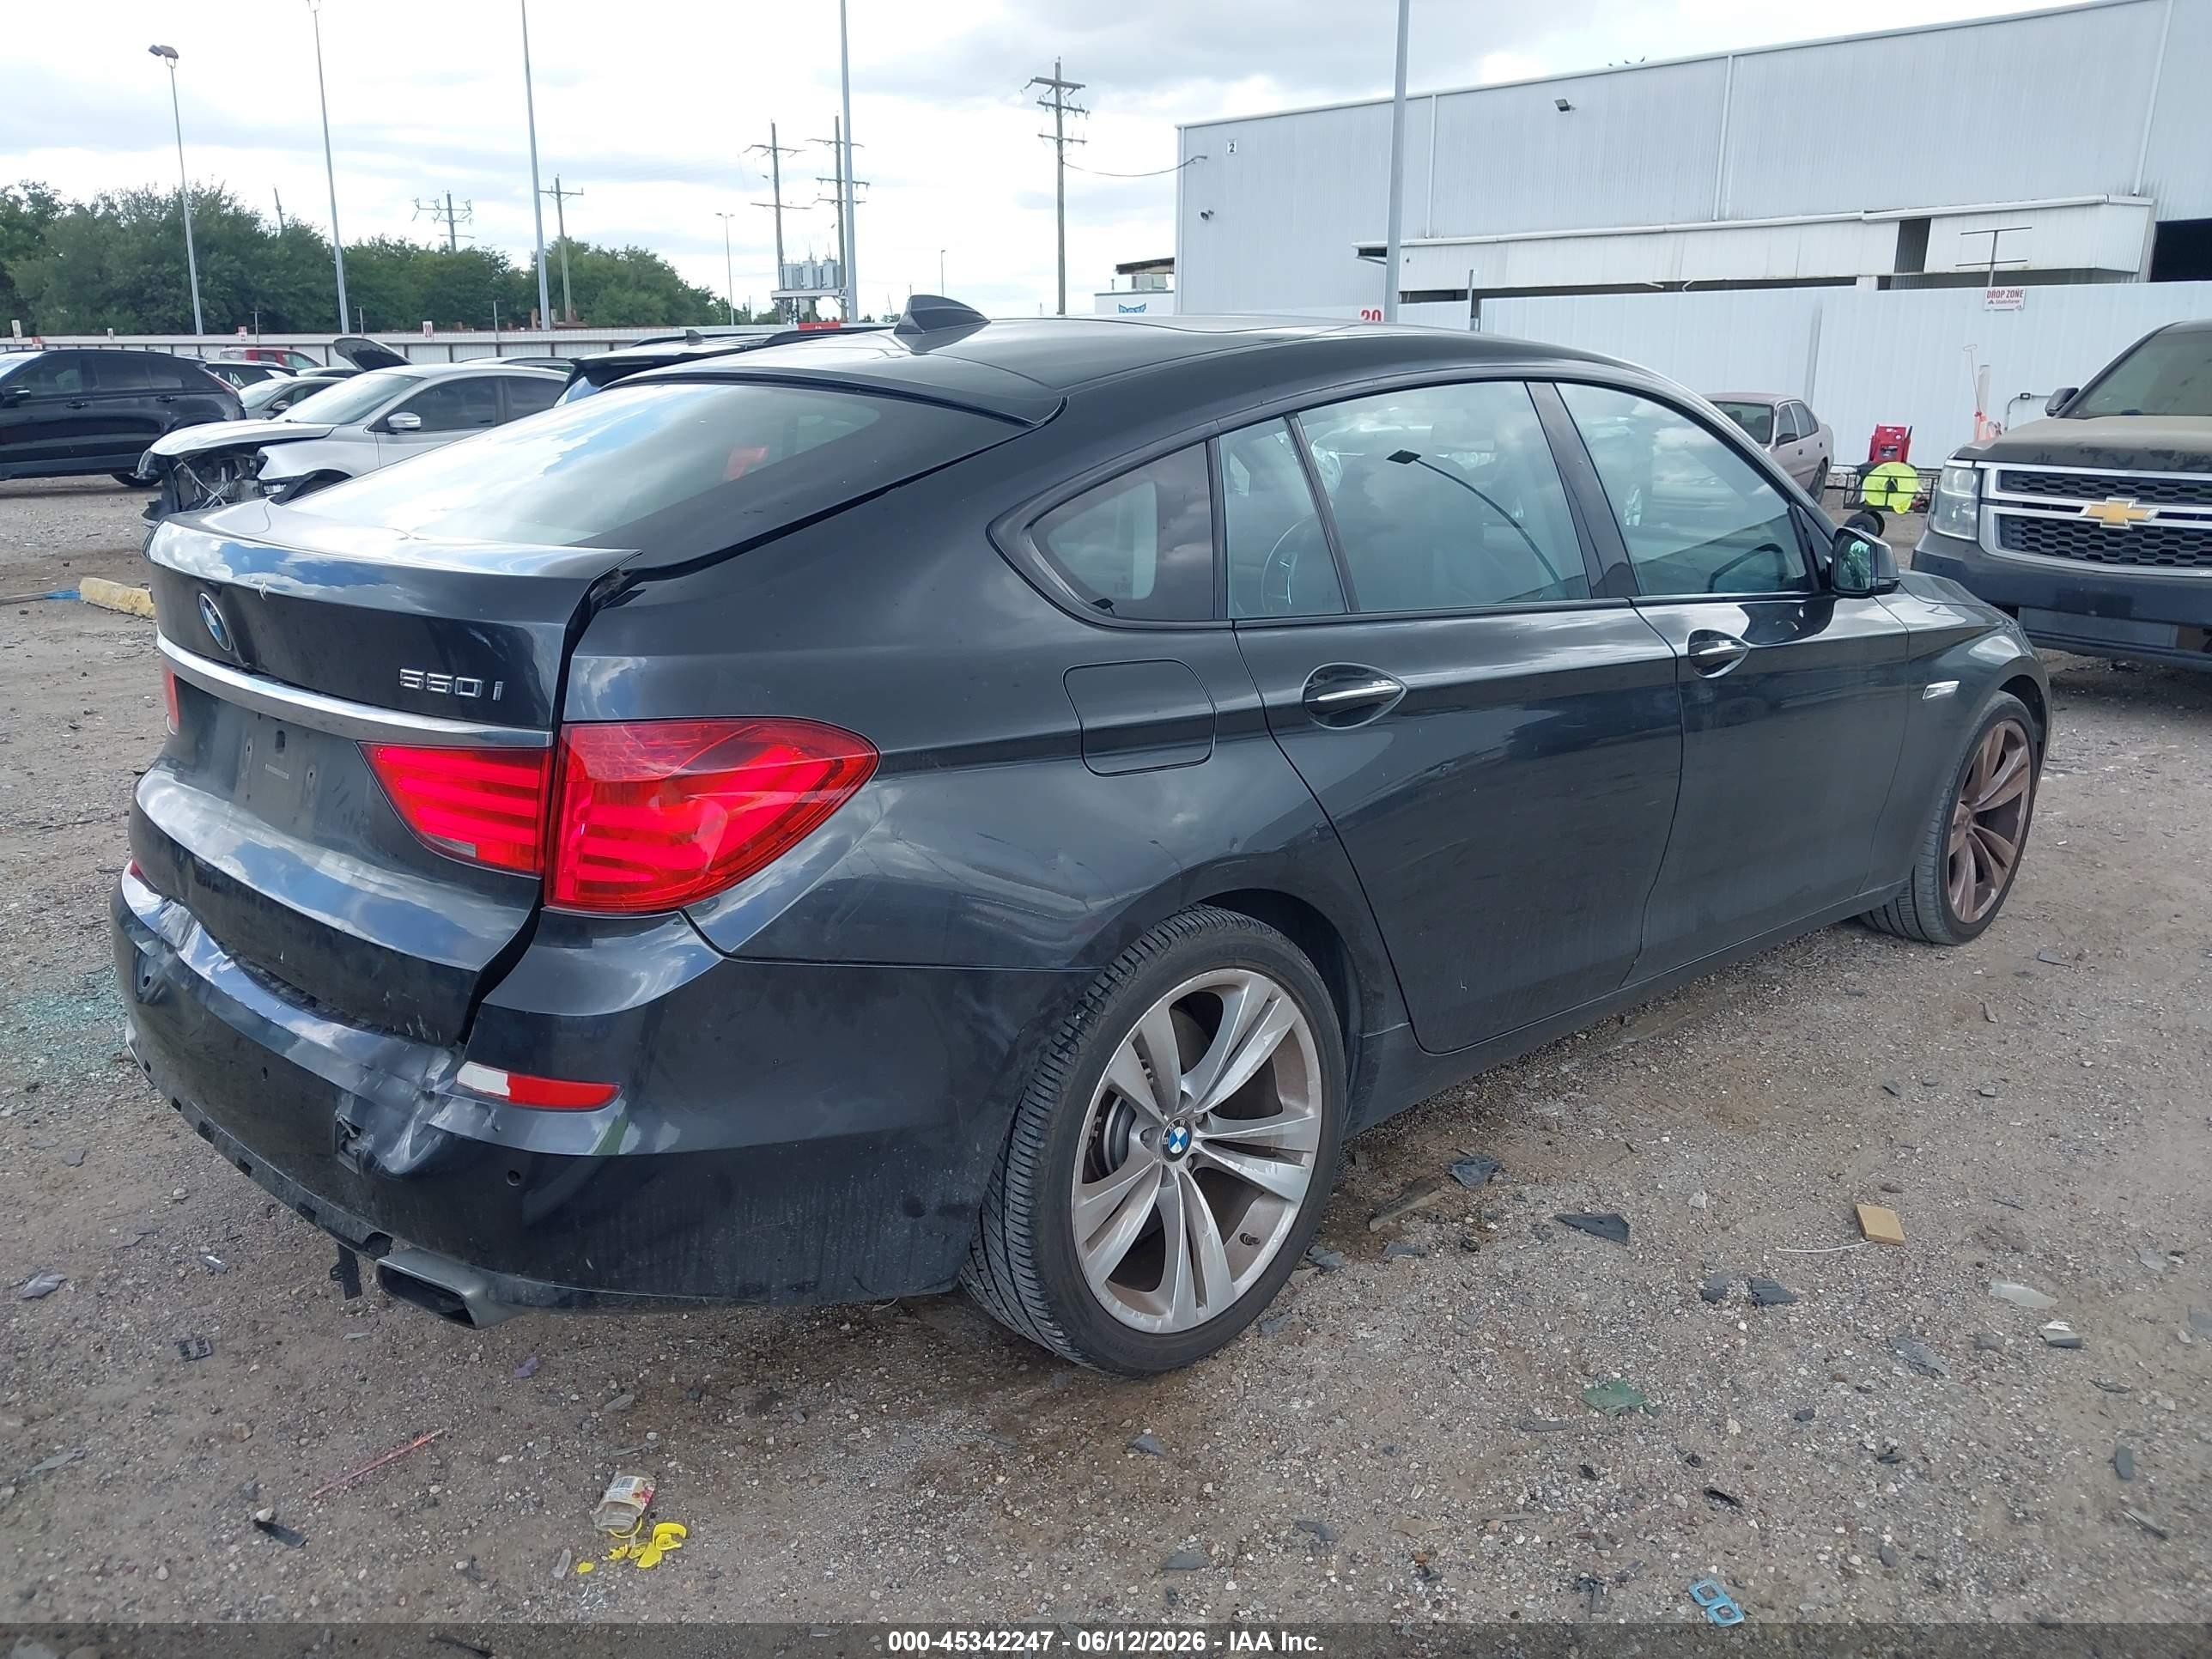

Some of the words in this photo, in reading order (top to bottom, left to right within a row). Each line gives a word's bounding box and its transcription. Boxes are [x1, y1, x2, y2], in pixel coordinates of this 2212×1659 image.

[1229, 143, 1235, 153] 2
[1986, 290, 2006, 299] DROP
[2006, 289, 2024, 298] ZONE
[1162, 1119, 1186, 1146] BMW
